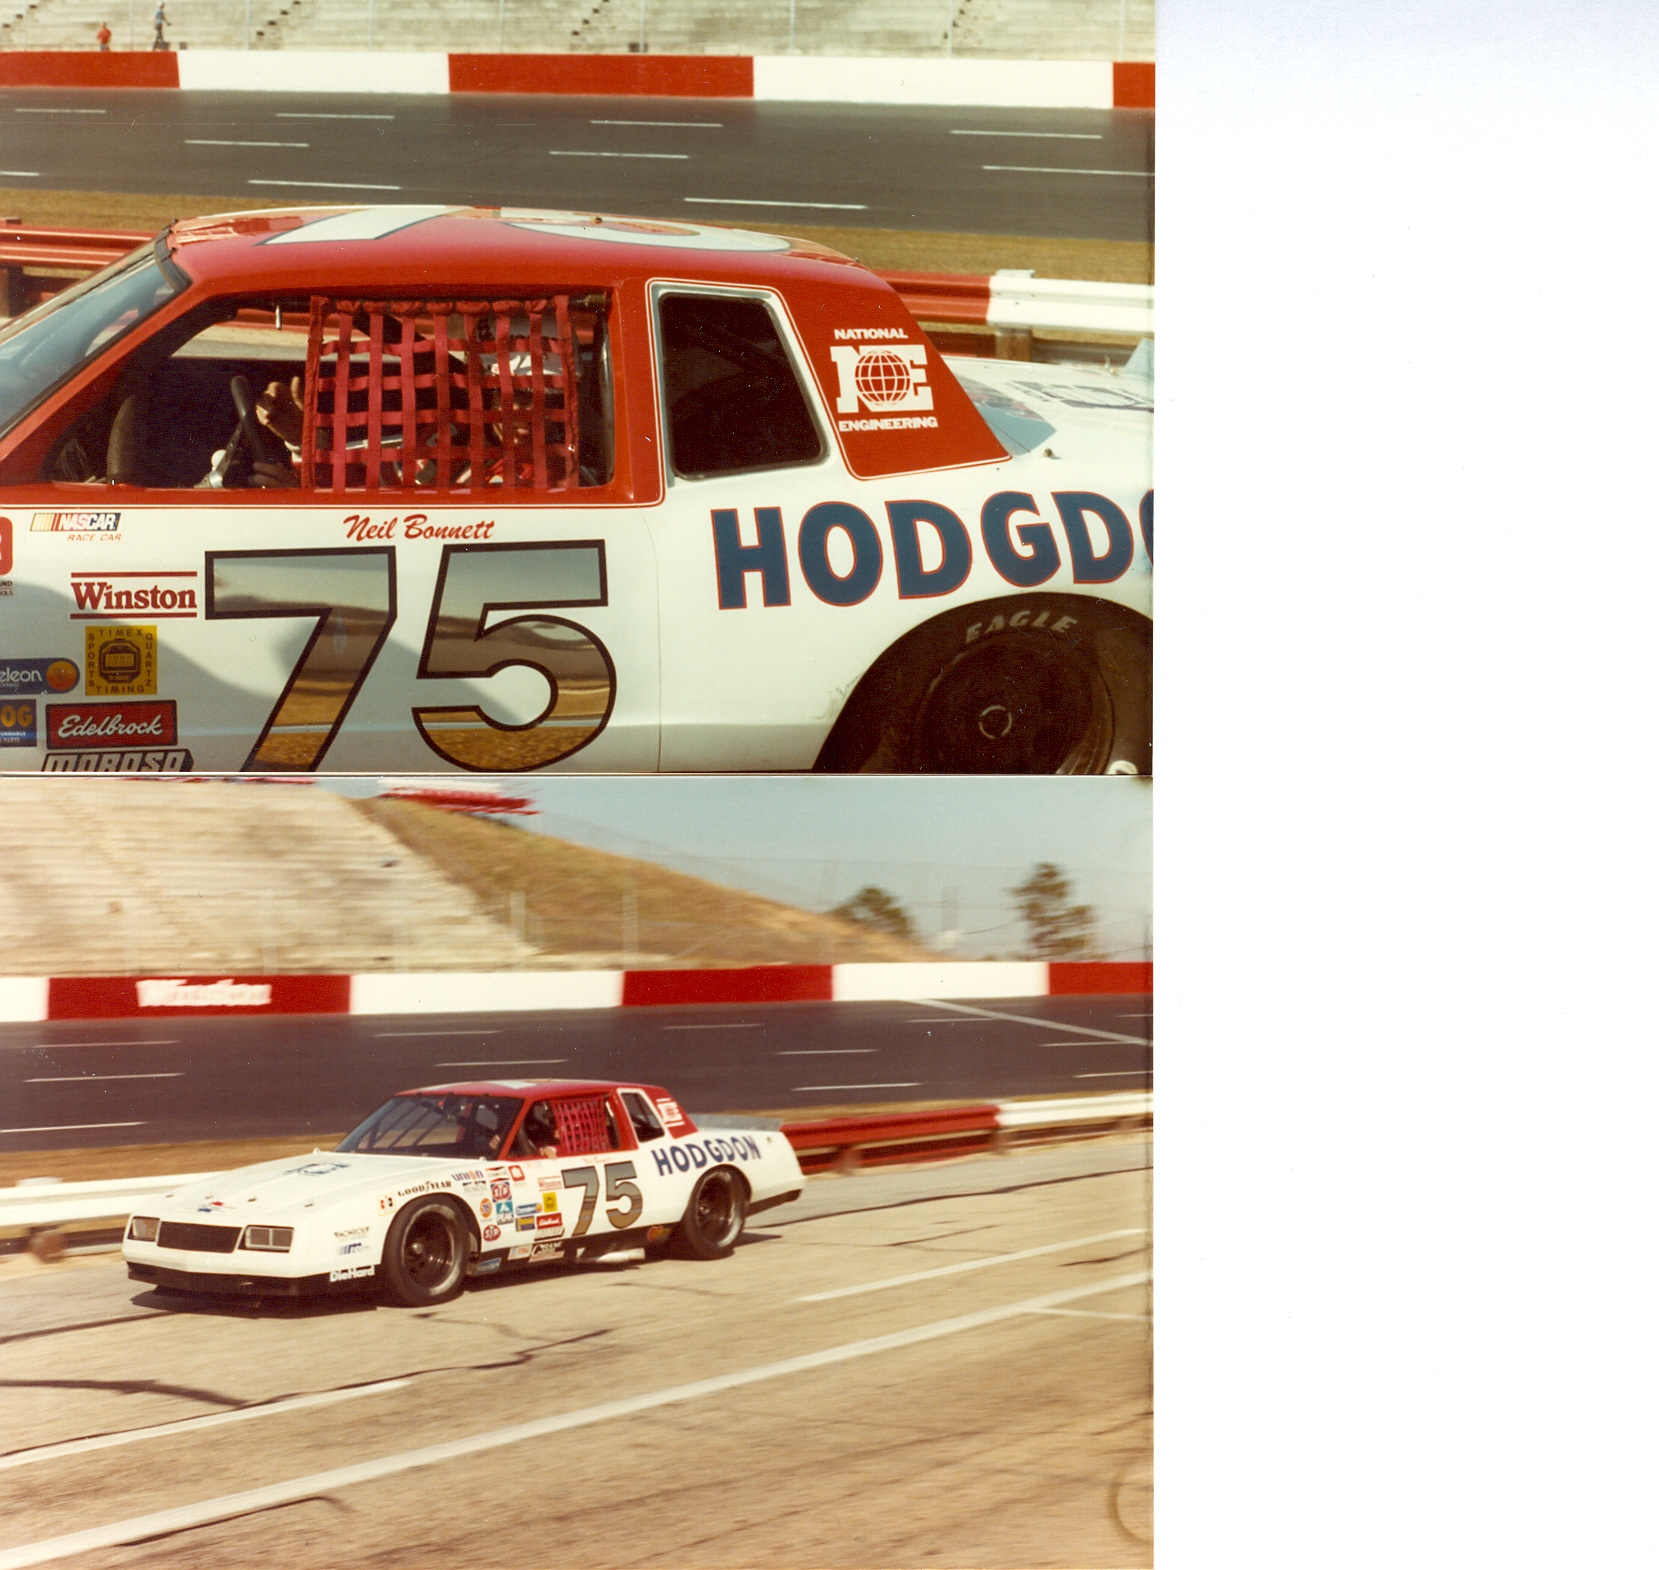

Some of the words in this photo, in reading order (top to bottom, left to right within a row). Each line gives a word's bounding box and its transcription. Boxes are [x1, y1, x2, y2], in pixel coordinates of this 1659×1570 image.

[834, 328, 908, 340] NATIONAL
[838, 416, 939, 432] ENGINEERING
[58, 513, 117, 531] NASCAR
[343, 514, 398, 541] Neil
[402, 513, 495, 540] Bonnett
[68, 533, 97, 542] RACE
[100, 533, 122, 542] CAR
[711, 491, 1154, 611] HODGD
[71, 582, 198, 611] Winston
[99, 628, 144, 637] TIMEX
[966, 610, 1079, 644] EAGLE
[88, 633, 96, 687] SPORTS
[145, 632, 153, 687] QUARTZ
[205, 539, 618, 773] 75
[96, 685, 145, 694] TIMING
[57, 713, 163, 739] Edelbrock
[651, 1135, 762, 1176] HODGDON
[492, 1183, 510, 1201] STP
[561, 1160, 643, 1237] 75
[484, 1225, 500, 1241] STP
[329, 1264, 375, 1282] DieHard
